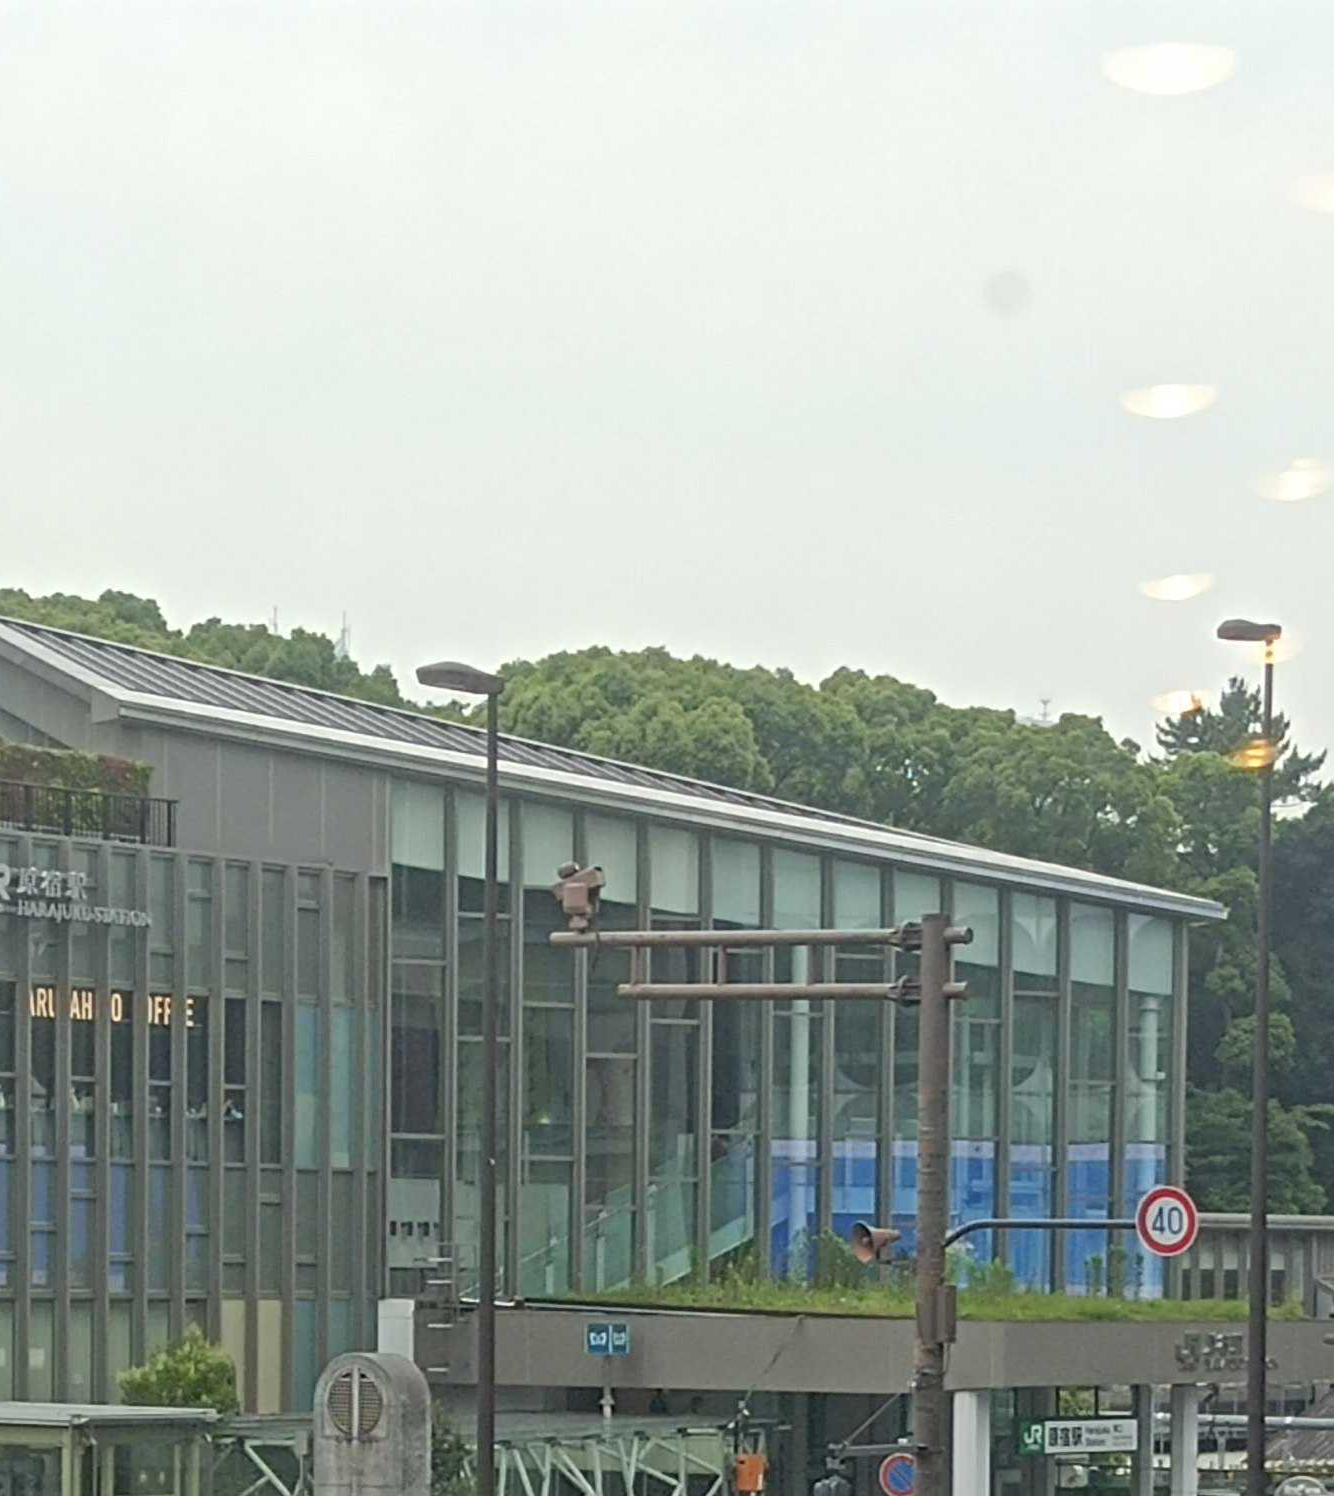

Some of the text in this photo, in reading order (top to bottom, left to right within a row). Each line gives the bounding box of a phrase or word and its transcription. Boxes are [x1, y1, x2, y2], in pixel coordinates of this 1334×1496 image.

[17, 866, 88, 900] 原宿駅
[1152, 1206, 1183, 1235] 40
[1023, 1424, 1043, 1444] JR
